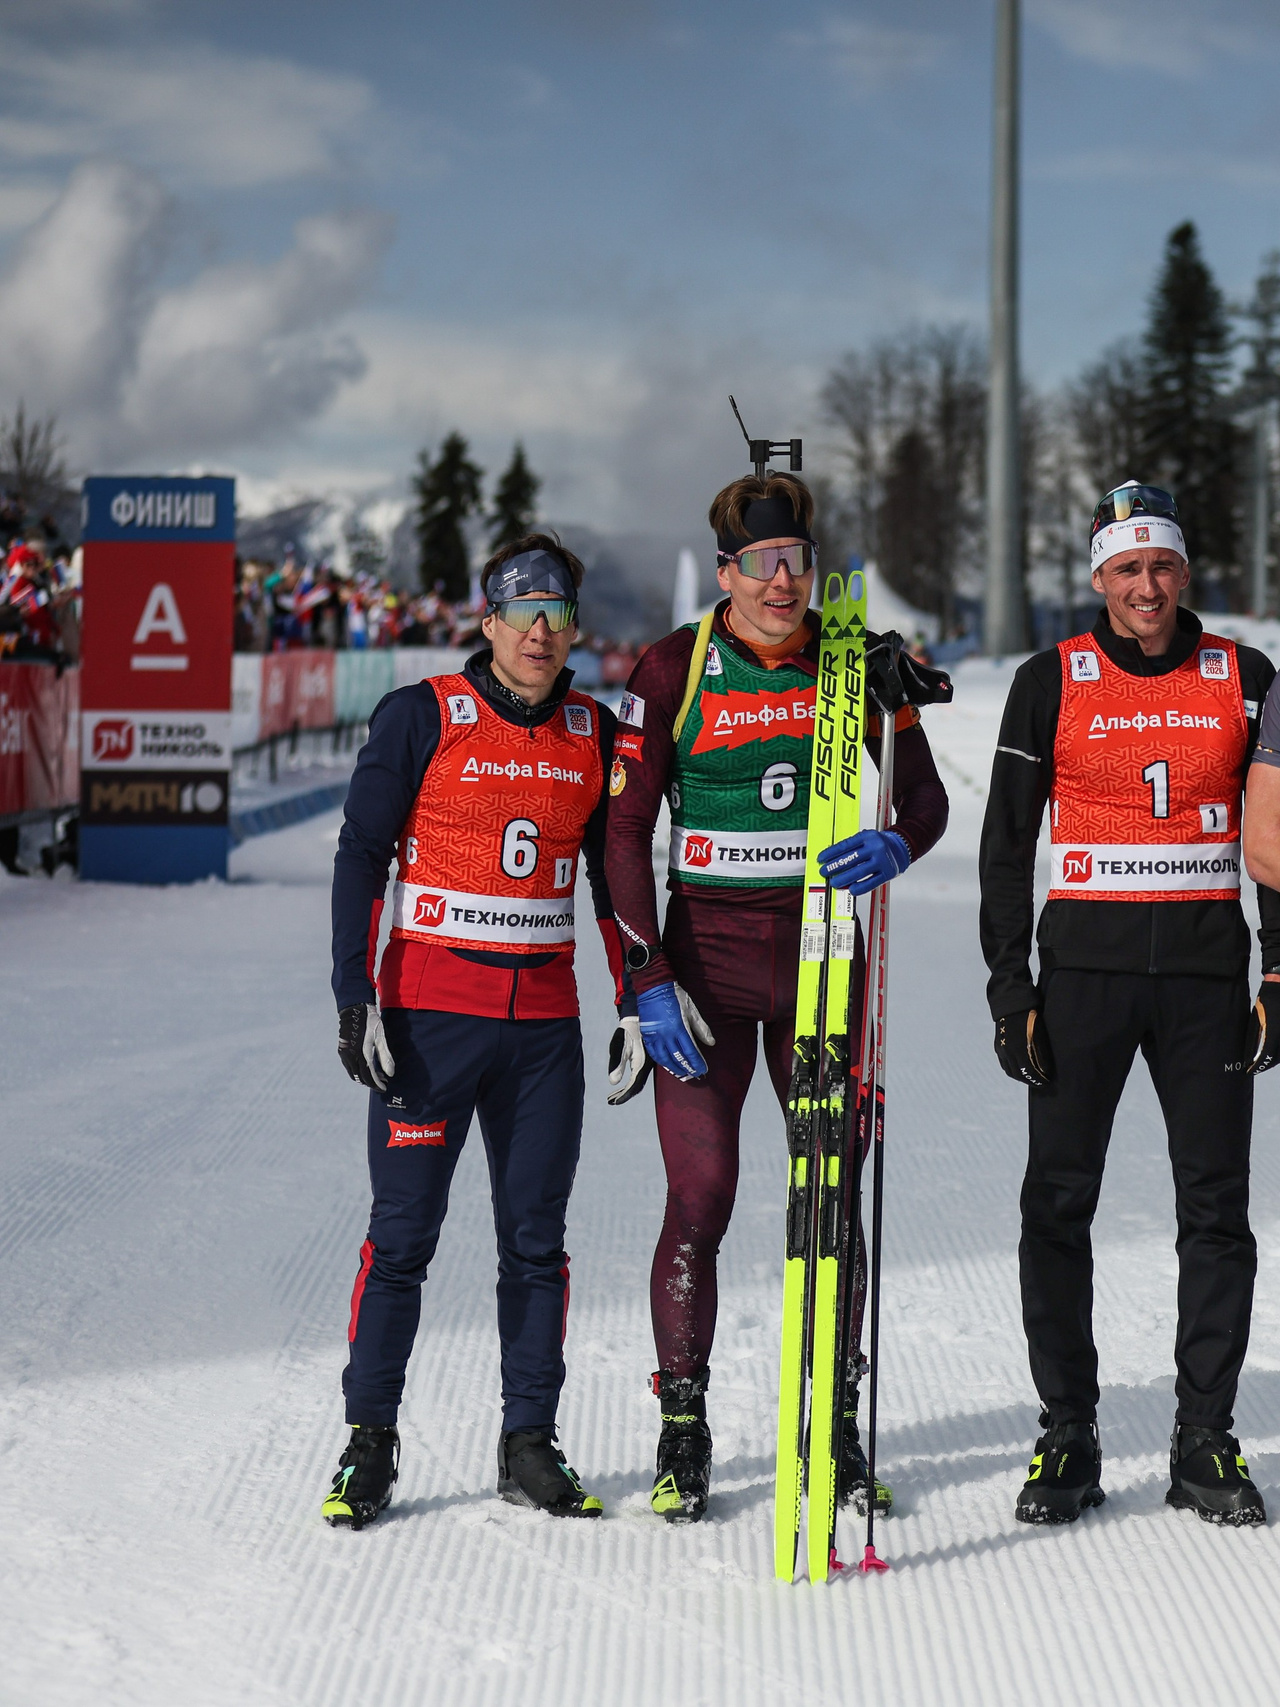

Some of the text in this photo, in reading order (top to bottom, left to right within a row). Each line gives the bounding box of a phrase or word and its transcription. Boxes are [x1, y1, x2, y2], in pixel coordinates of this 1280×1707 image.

[110, 493, 216, 528] ФИНИШ
[1092, 539, 1104, 557] AX
[1204, 658, 1223, 667] 2025
[1205, 666, 1224, 675] 2026
[569, 714, 587, 723] 2025
[571, 722, 588, 732] 2026
[713, 701, 817, 736] Альфа Ба
[815, 650, 839, 801] FISCHER
[840, 648, 862, 800] FISCHER
[1088, 710, 1222, 739] Альфа Банк
[140, 723, 205, 739] ТЕХНО
[141, 744, 223, 757] НИКОЛЬ
[622, 739, 638, 751] Банк
[460, 757, 584, 786] Альфа Банк
[671, 782, 681, 809] 6
[759, 762, 799, 812] 6
[1142, 760, 1169, 819] 1
[1210, 808, 1218, 828] 1
[406, 836, 419, 865] 6
[501, 818, 540, 879] 6
[717, 845, 807, 864] ТЕХНОН
[560, 863, 567, 884] 1
[1097, 859, 1238, 875] ТЕХНОНИКОЛЬ
[451, 907, 575, 928] ТЕХНОНИКОЛЬ
[1020, 1067, 1042, 1087] MOAX
[395, 1129, 442, 1141] Альфа Банк
[1057, 1453, 1069, 1478] FISCHER
[1211, 1454, 1224, 1479] FISCHER
